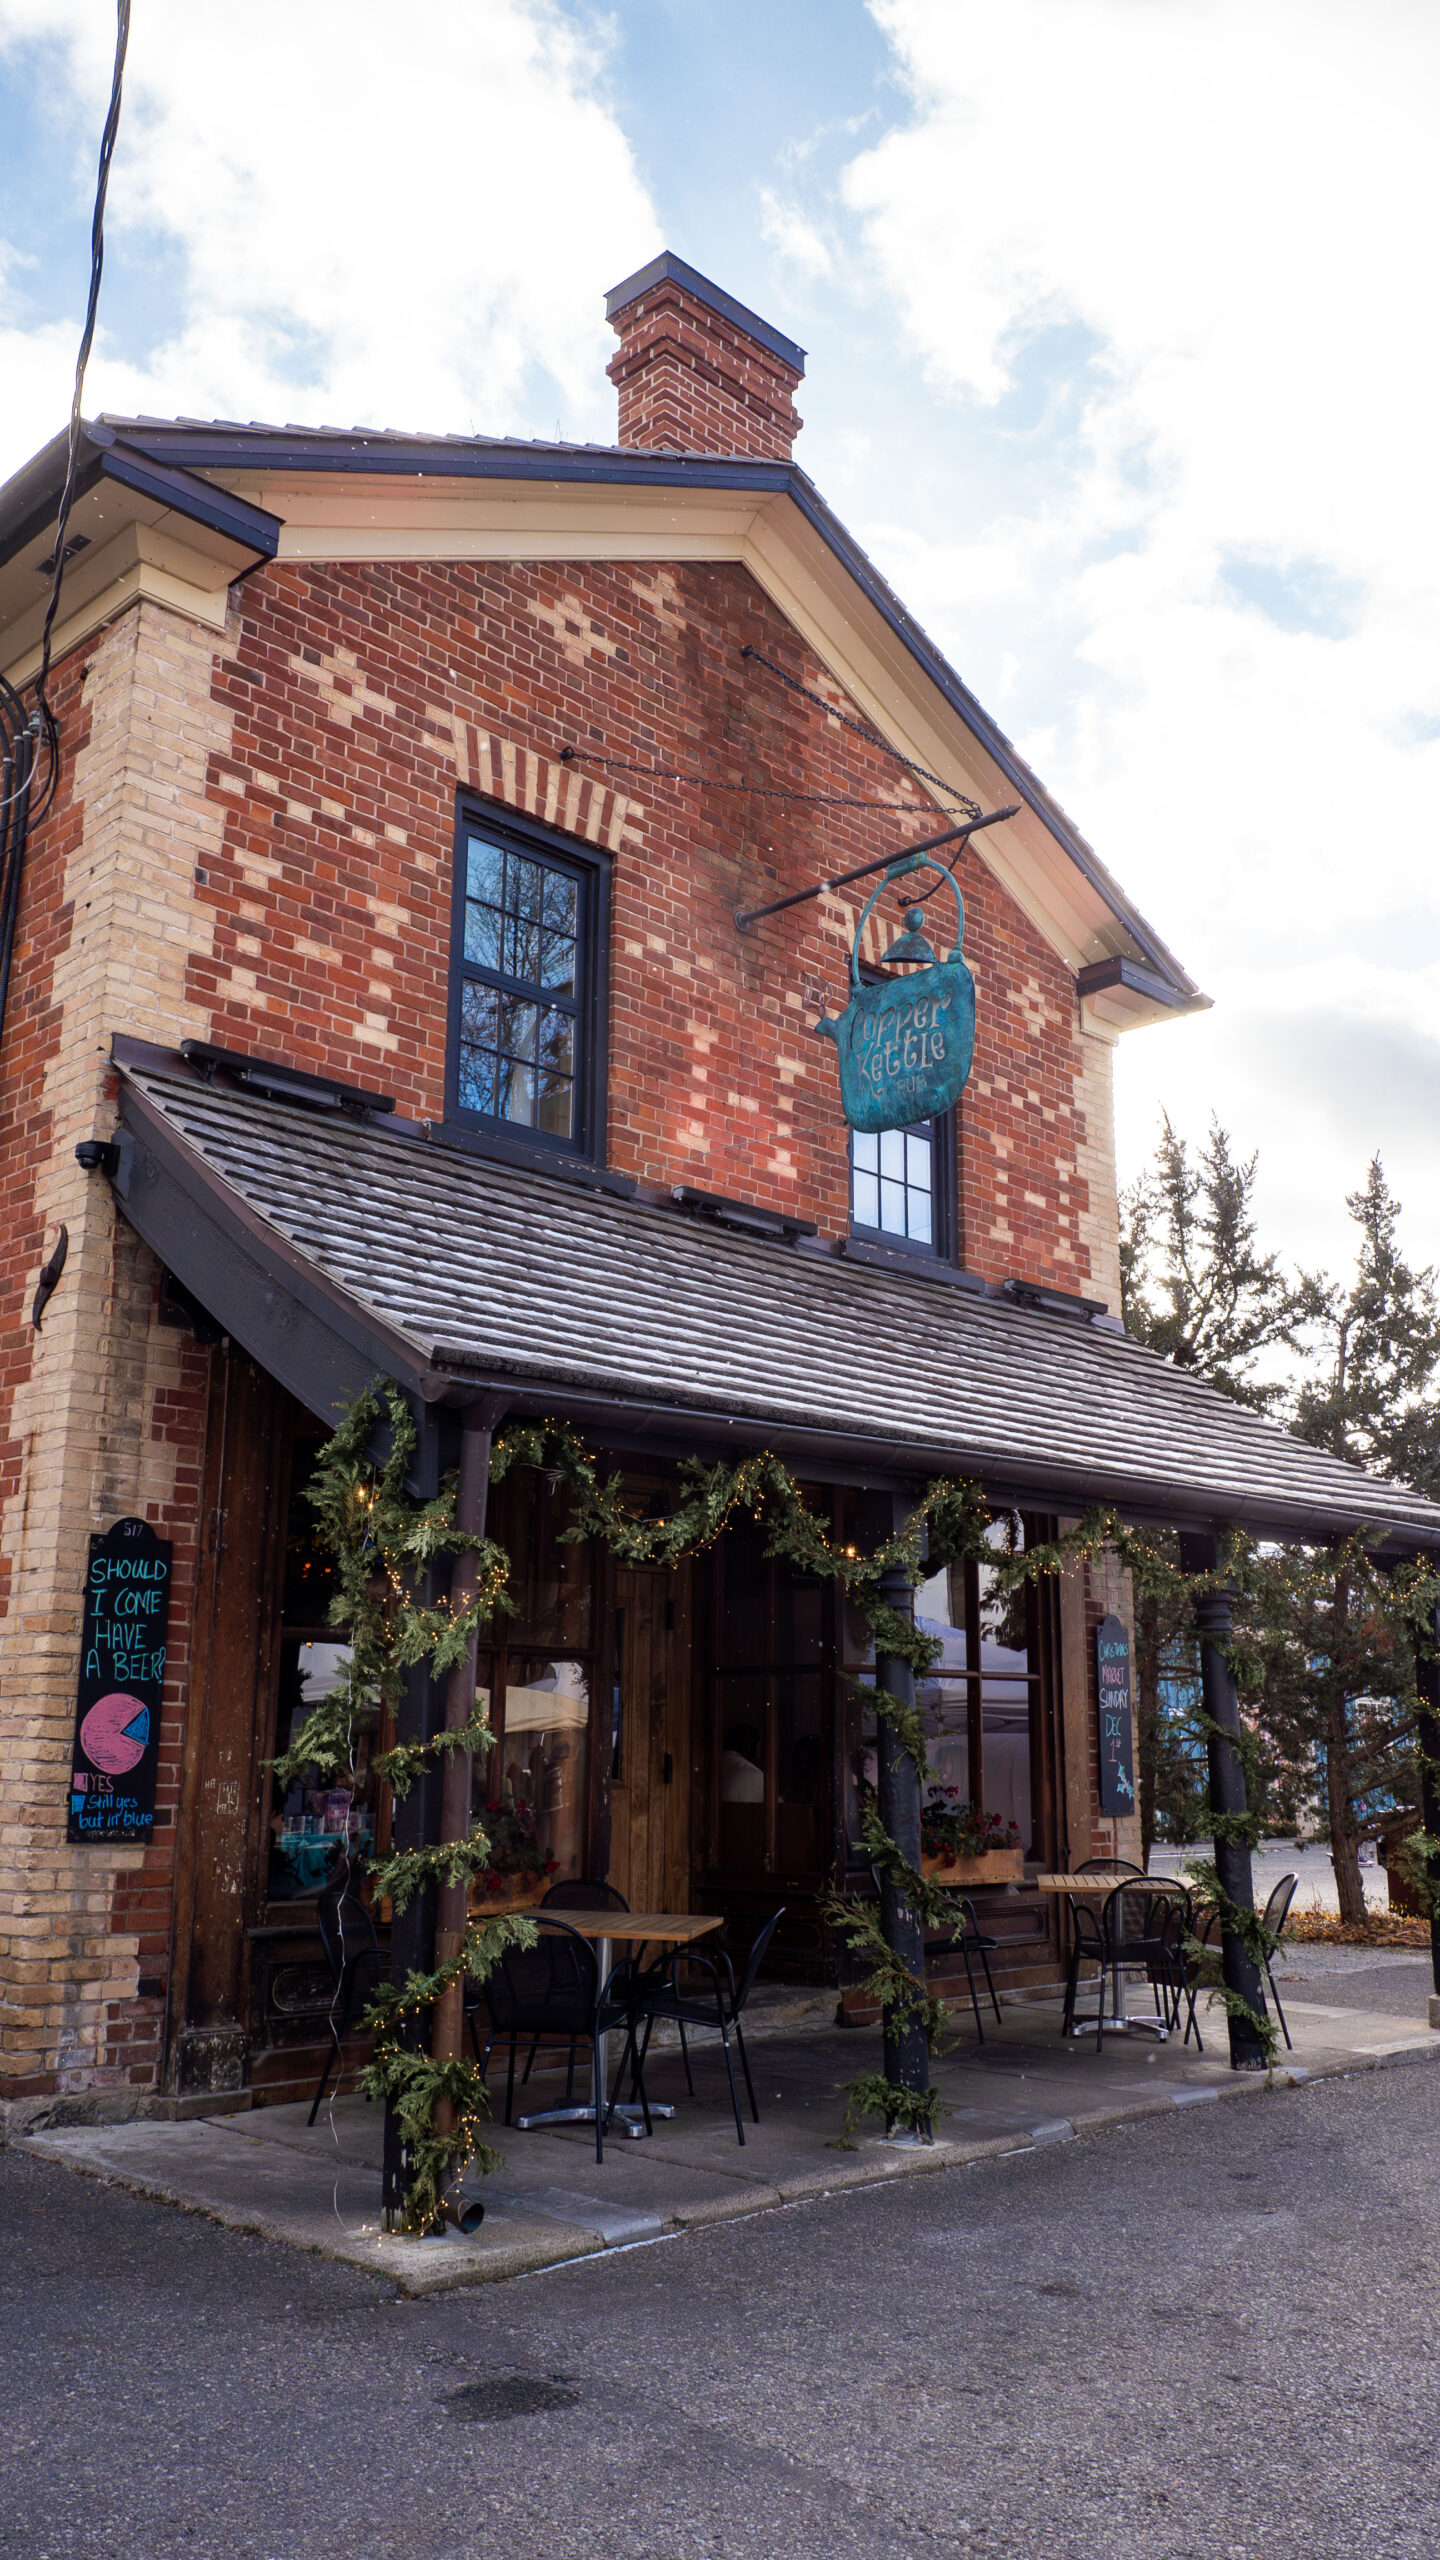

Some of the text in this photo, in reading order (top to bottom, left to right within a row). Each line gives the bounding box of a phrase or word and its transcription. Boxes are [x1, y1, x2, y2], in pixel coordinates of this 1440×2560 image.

[850, 992, 952, 1053] Copper
[89, 1558, 168, 1583] SHOULD
[90, 1587, 163, 1618] I COME
[95, 1619, 148, 1650] HAVE
[86, 1646, 167, 1684] A BEER?
[1099, 1687, 1129, 1710] SUNDAY
[1105, 1713, 1122, 1738] DEC
[90, 1772, 114, 1793] YES
[116, 1797, 139, 1817] yes
[79, 1810, 154, 1830] but in blue
